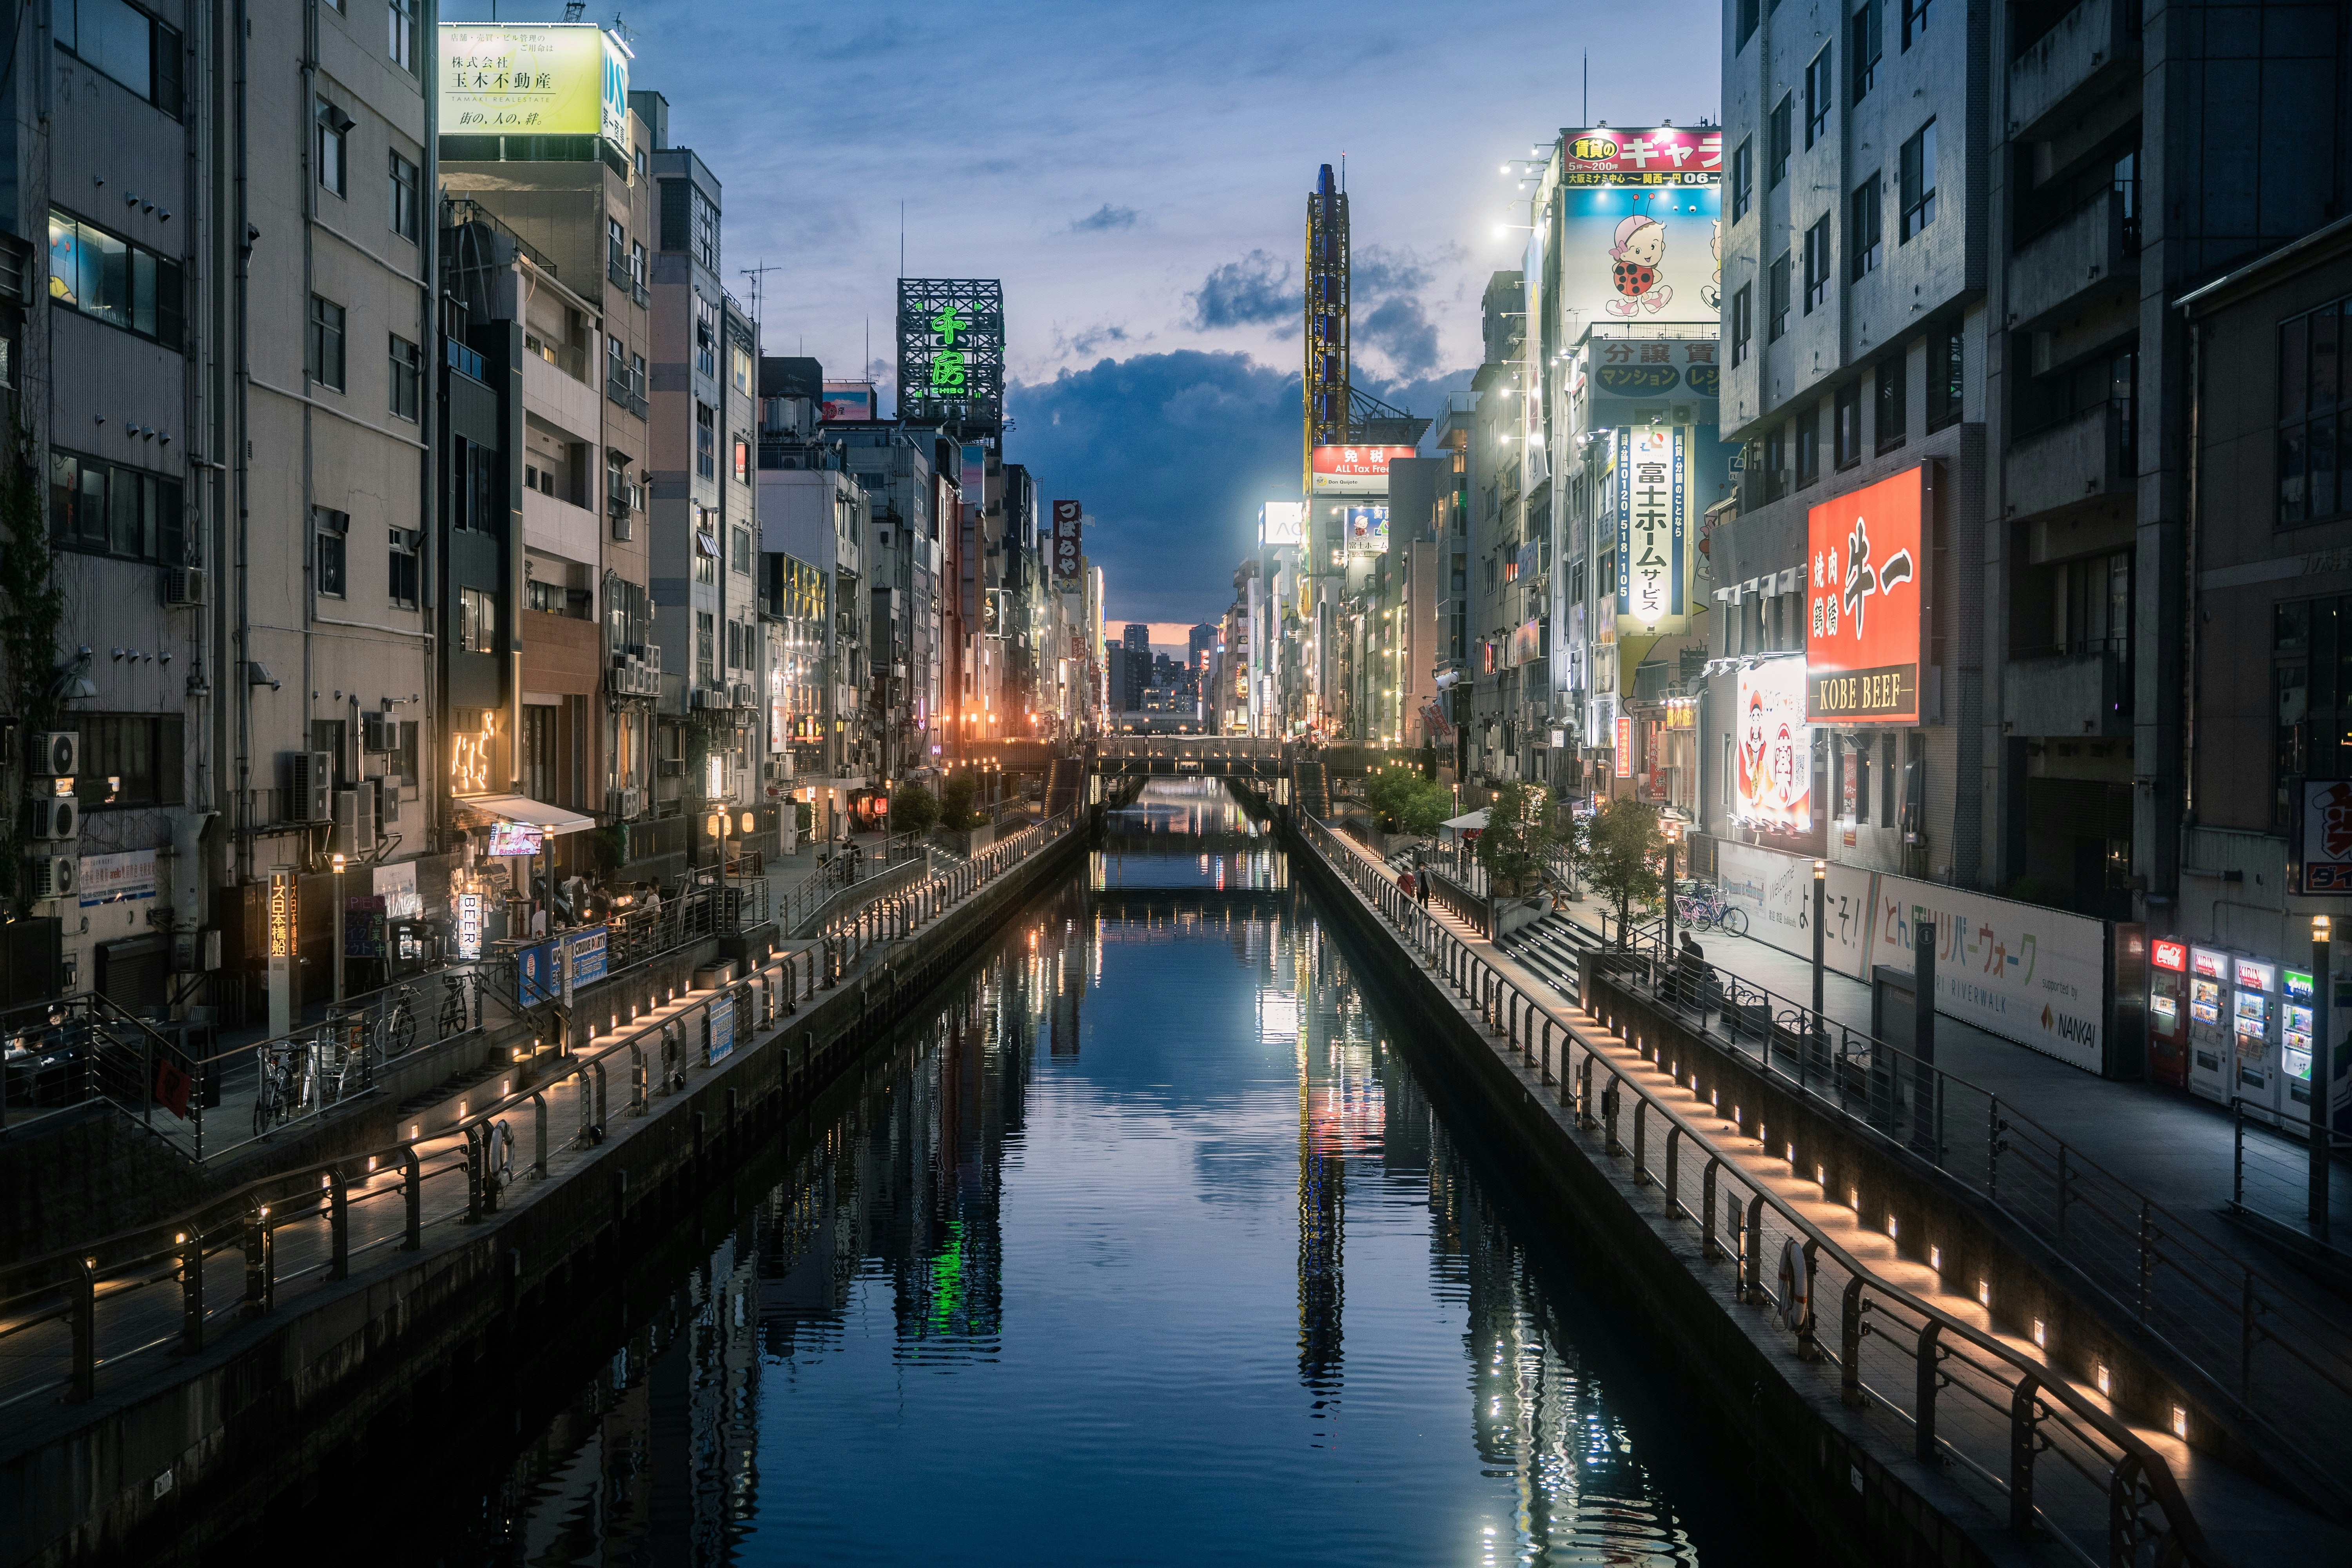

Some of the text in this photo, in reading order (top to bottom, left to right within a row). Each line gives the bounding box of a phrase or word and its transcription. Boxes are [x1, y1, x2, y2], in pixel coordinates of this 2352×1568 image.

[520, 44, 554, 53] ご用命は
[451, 56, 508, 69] 株式会社
[451, 72, 552, 89] 玉木不動産
[459, 112, 542, 126] 街の、人の、絆。
[1575, 140, 1615, 158] 賃貸の
[931, 306, 966, 385] 千房
[1603, 343, 1671, 364] 分譲
[1601, 368, 1676, 387] マンション
[1335, 465, 1351, 473] ALL
[1354, 465, 1370, 473] Tax
[1675, 435, 1683, 537] 賃貸・分譲のことなら
[1635, 461, 1667, 610] 富士ホームサービス
[1813, 546, 1838, 588] 焼肉
[1813, 592, 1839, 639] 鶴橋
[1820, 675, 1857, 711] KOBE
[1862, 671, 1901, 708] BEEF
[1769, 865, 1795, 902] Welcome
[345, 897, 385, 909] PEN
[272, 874, 286, 957] ーズ日本橋船
[465, 897, 475, 943] BEER
[370, 913, 385, 957] 営業中
[575, 940, 591, 956] CRUISE
[592, 934, 606, 950] PARTY
[2195, 954, 2214, 969] KIRIN
[2239, 965, 2260, 980] KIRIN
[1951, 979, 2006, 1015] RIVERWALK
[2042, 978, 2078, 1001] supported by
[2058, 1013, 2095, 1049] NANKAI
